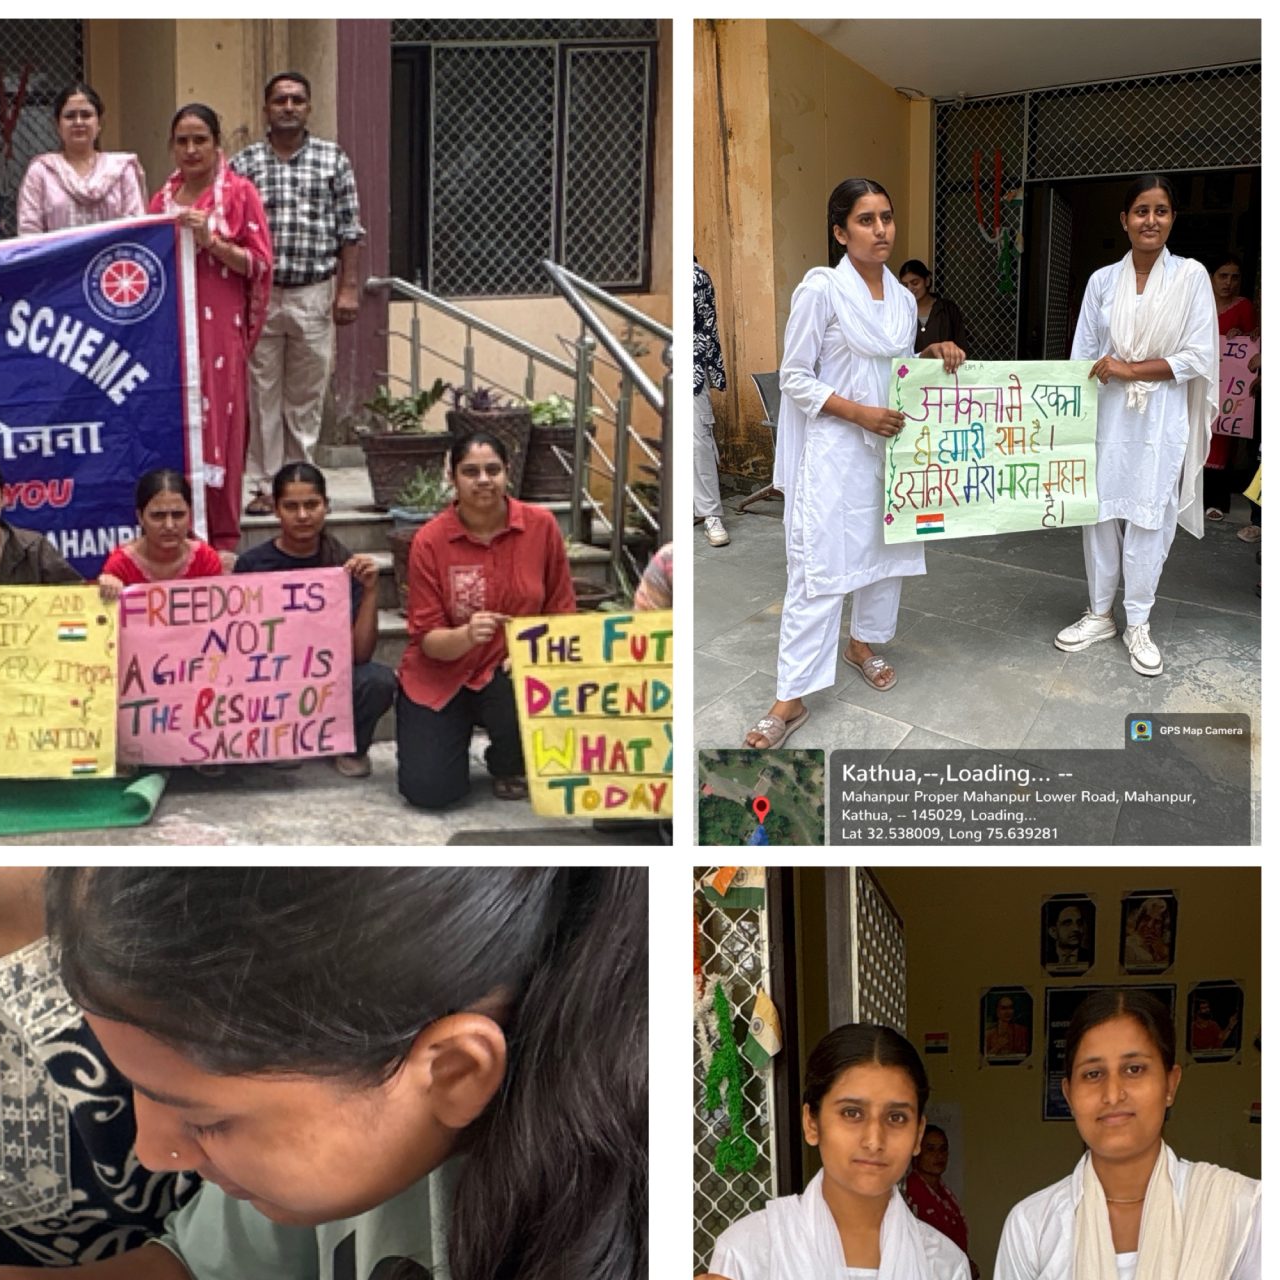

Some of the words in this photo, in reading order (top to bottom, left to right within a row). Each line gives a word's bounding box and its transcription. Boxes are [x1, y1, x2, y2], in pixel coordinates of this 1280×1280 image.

[5, 300, 150, 405] SCHEME
[1223, 343, 1248, 359] IS
[1222, 398, 1245, 414] OF
[1227, 377, 1245, 396] IS
[120, 586, 263, 627] FREEDOM
[282, 583, 325, 612] IS
[517, 624, 582, 663] THE
[120, 698, 182, 736] THE
[193, 688, 291, 729] RESULT
[298, 681, 336, 716] OF
[532, 727, 652, 776] WHAT
[548, 777, 667, 814] TODAY
